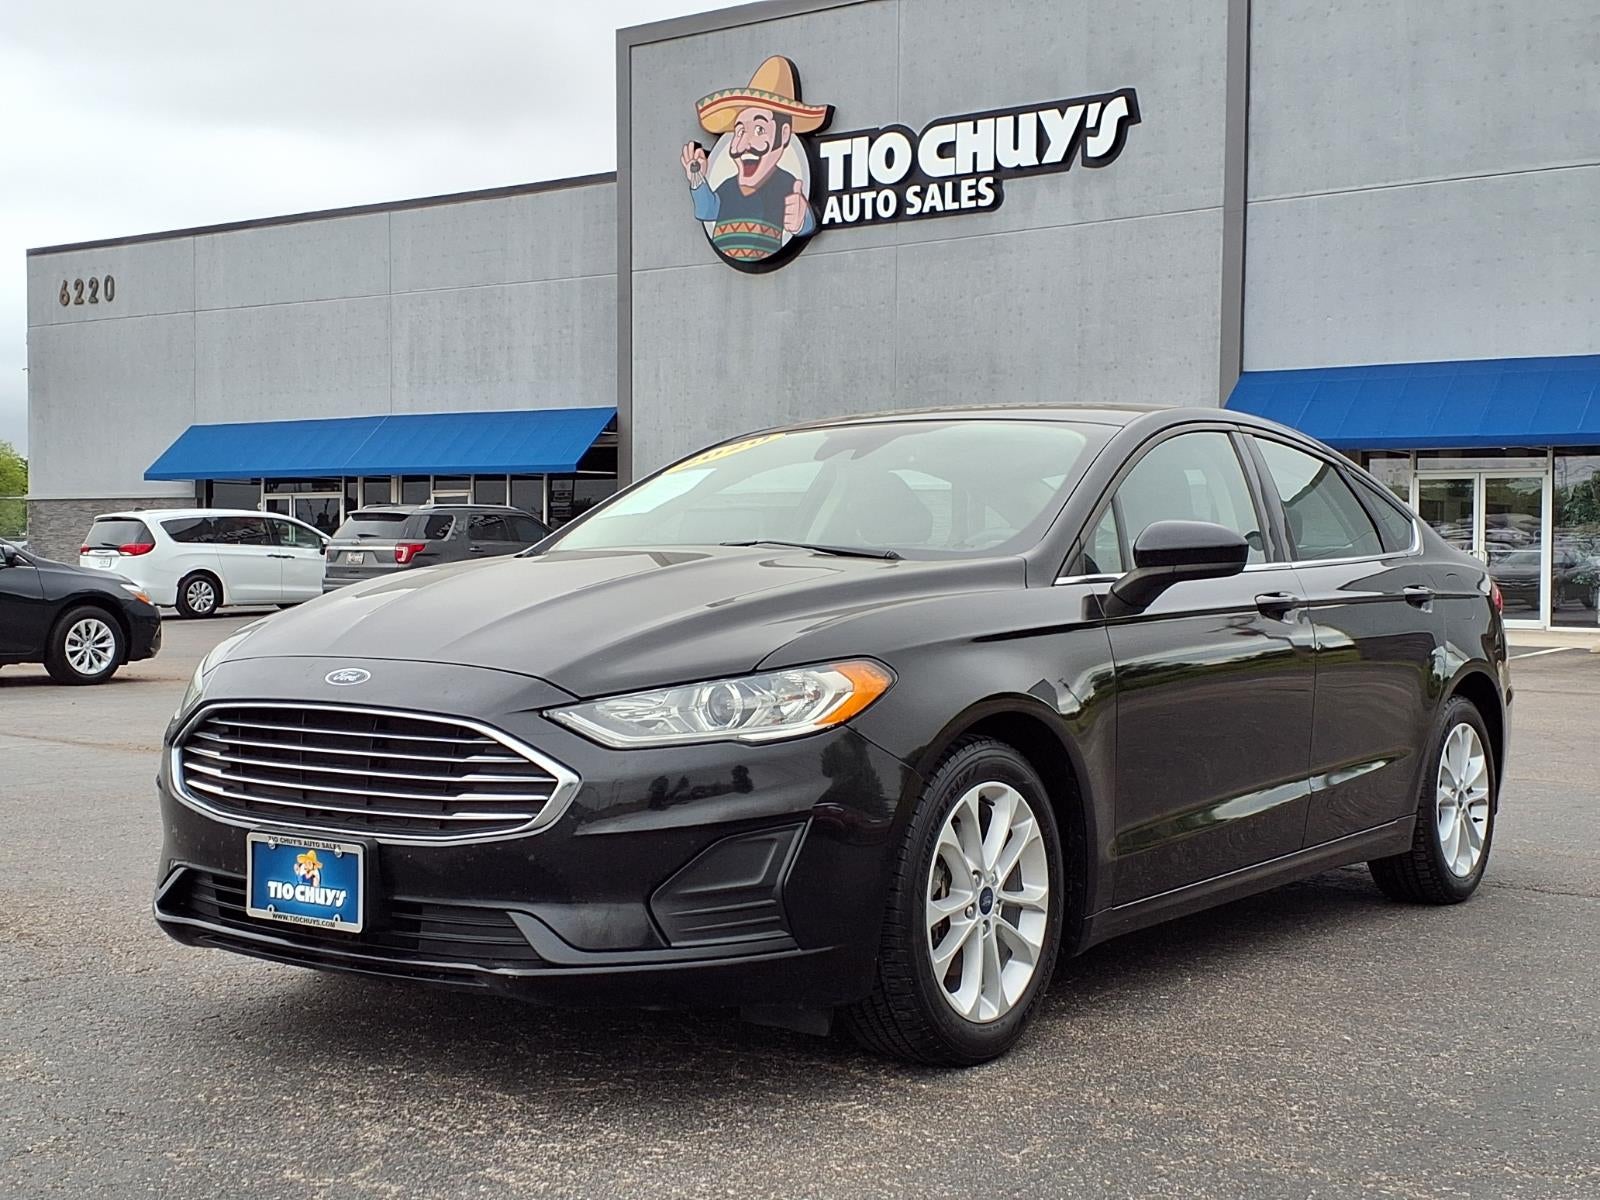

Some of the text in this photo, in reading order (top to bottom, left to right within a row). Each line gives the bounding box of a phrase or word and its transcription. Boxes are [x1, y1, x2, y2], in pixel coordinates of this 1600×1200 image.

[820, 96, 1129, 191] TIO CHUY'S
[822, 176, 995, 225] AUTO SALES
[59, 275, 115, 306] 6220
[303, 840, 320, 848] AUTO
[267, 881, 347, 907] TIO CHUY'S
